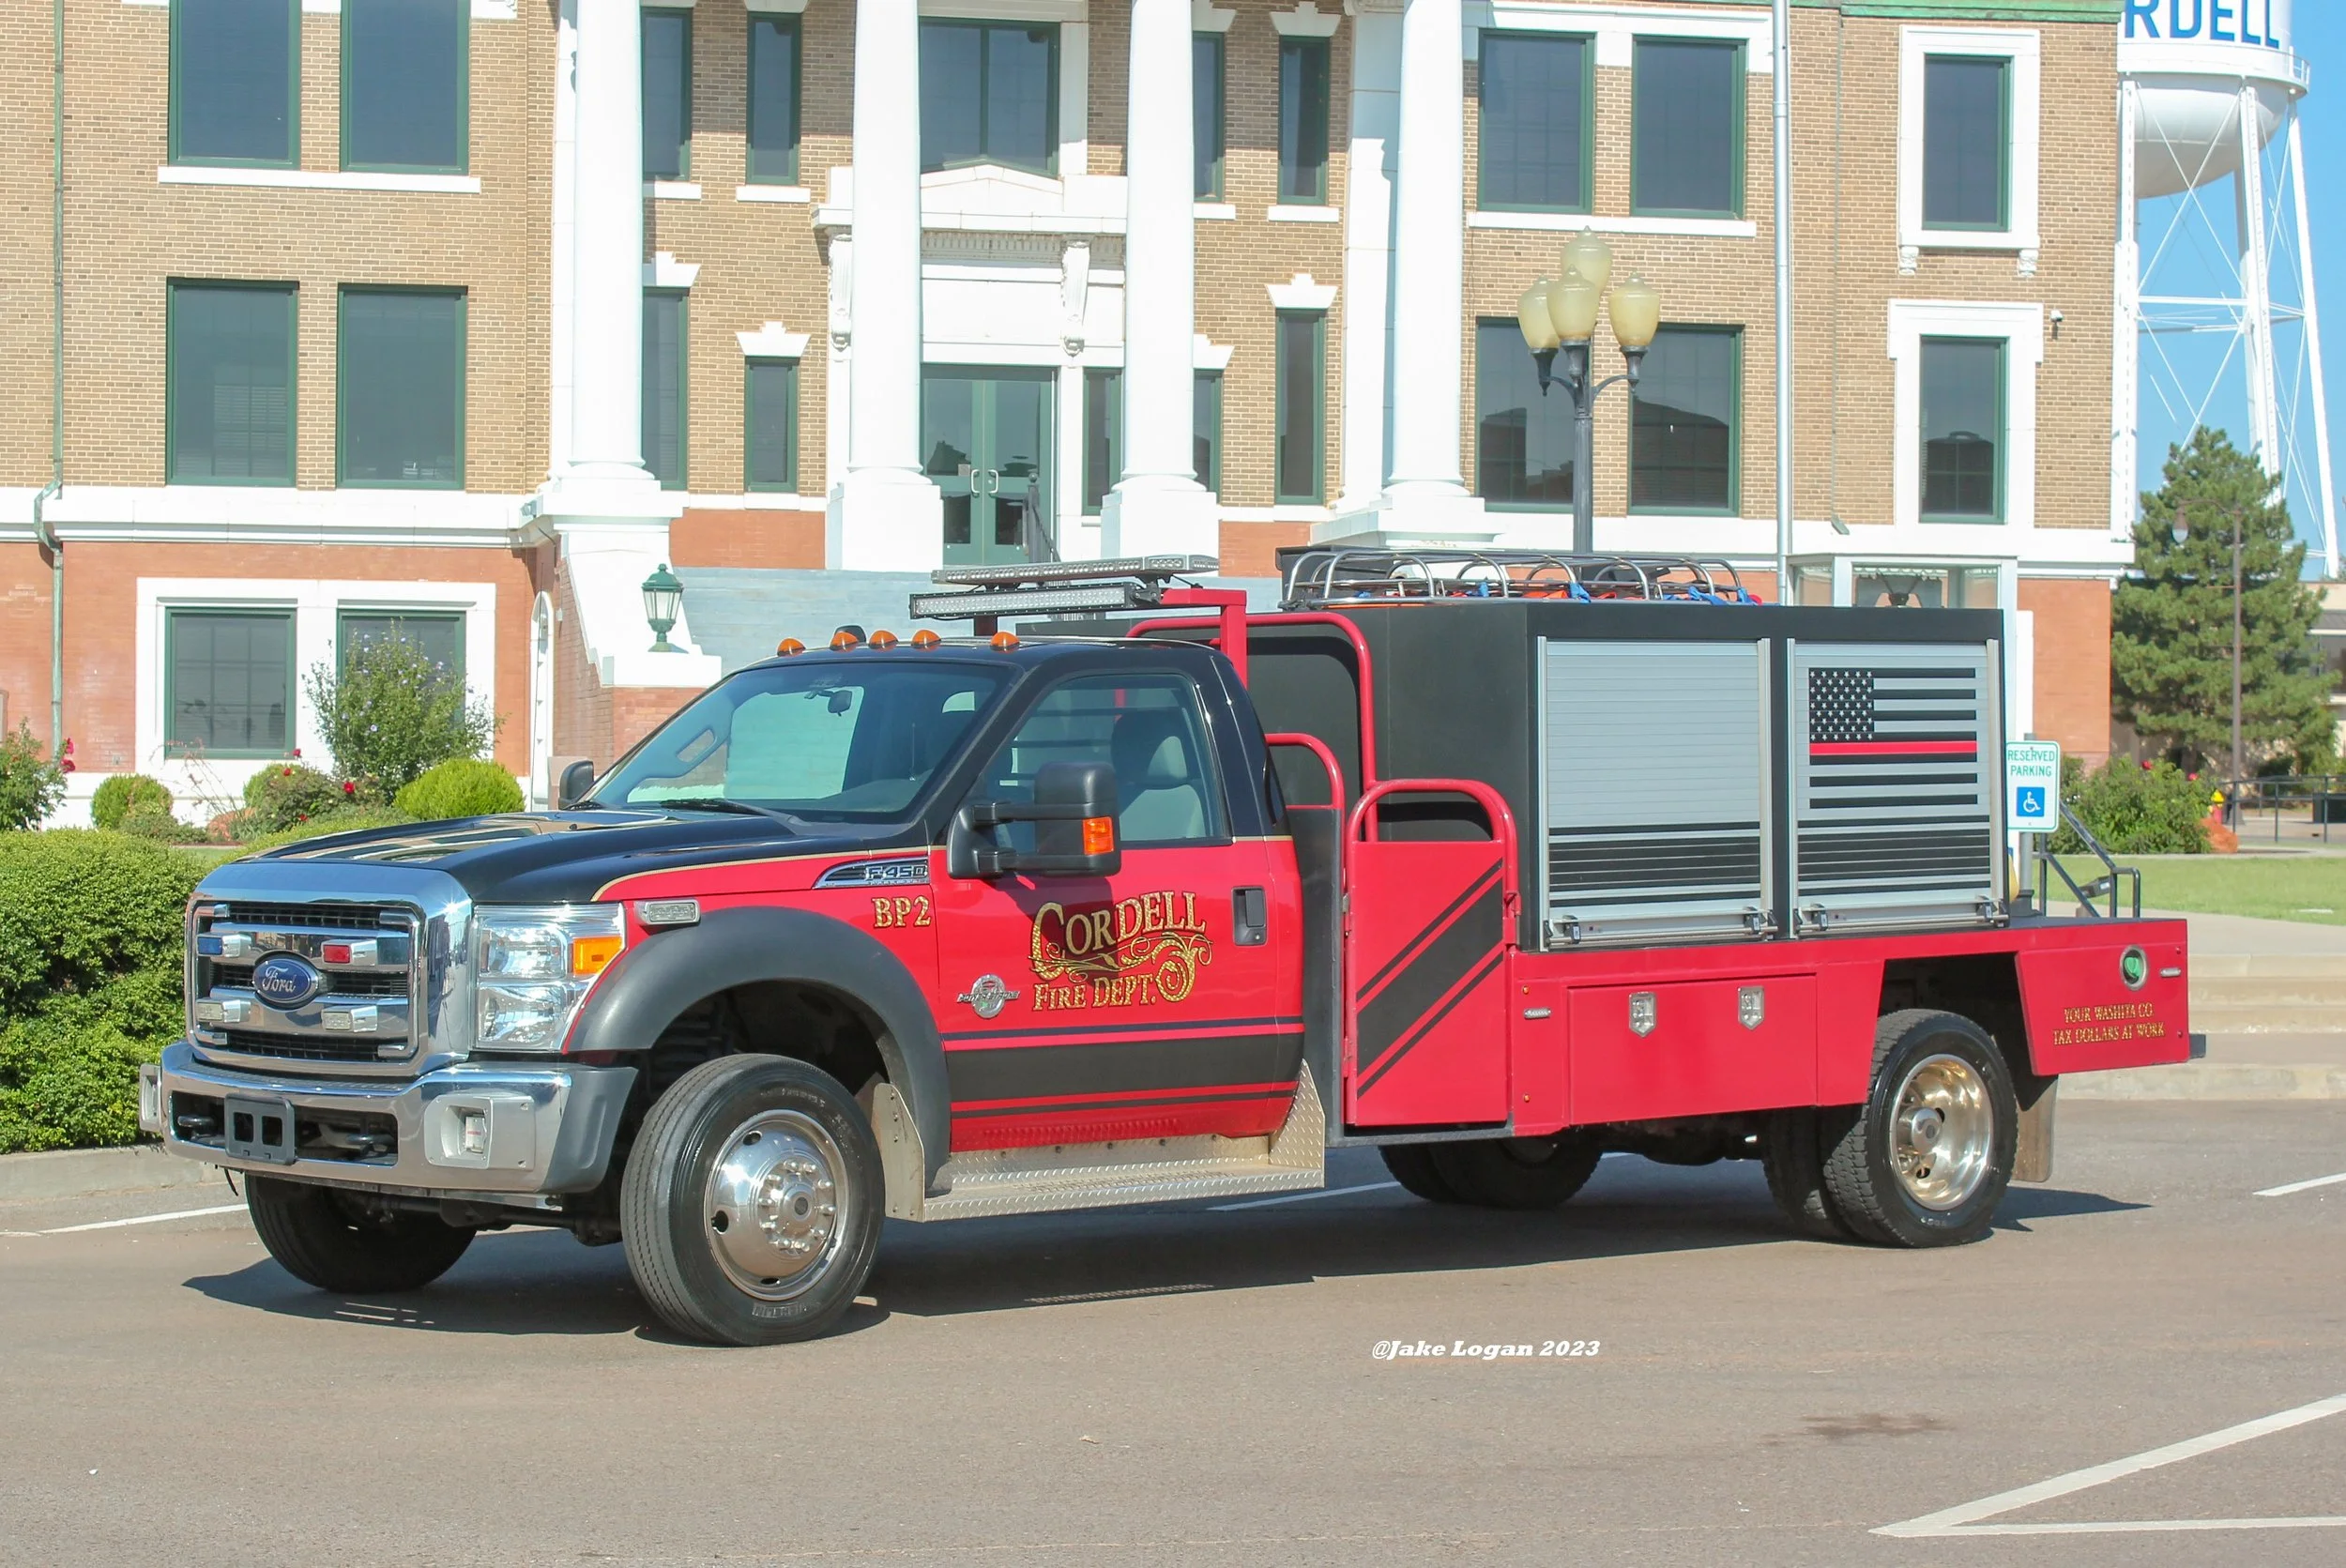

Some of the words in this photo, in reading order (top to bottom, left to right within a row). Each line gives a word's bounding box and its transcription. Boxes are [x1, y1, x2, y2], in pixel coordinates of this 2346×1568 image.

[2125, 0, 2279, 49] RDELL
[2007, 750, 2055, 762] RESERVED
[2010, 765, 2052, 777] PARKING
[872, 895, 931, 927] BP2
[262, 966, 297, 993] Ford
[2064, 1007, 2092, 1024] YOUR
[2094, 1003, 2137, 1021] WASHITA
[2053, 1029, 2072, 1045] TAX
[2075, 1026, 2120, 1043] DOLLARS
[2121, 1024, 2134, 1040] AT
[2136, 1022, 2165, 1038] WORK
